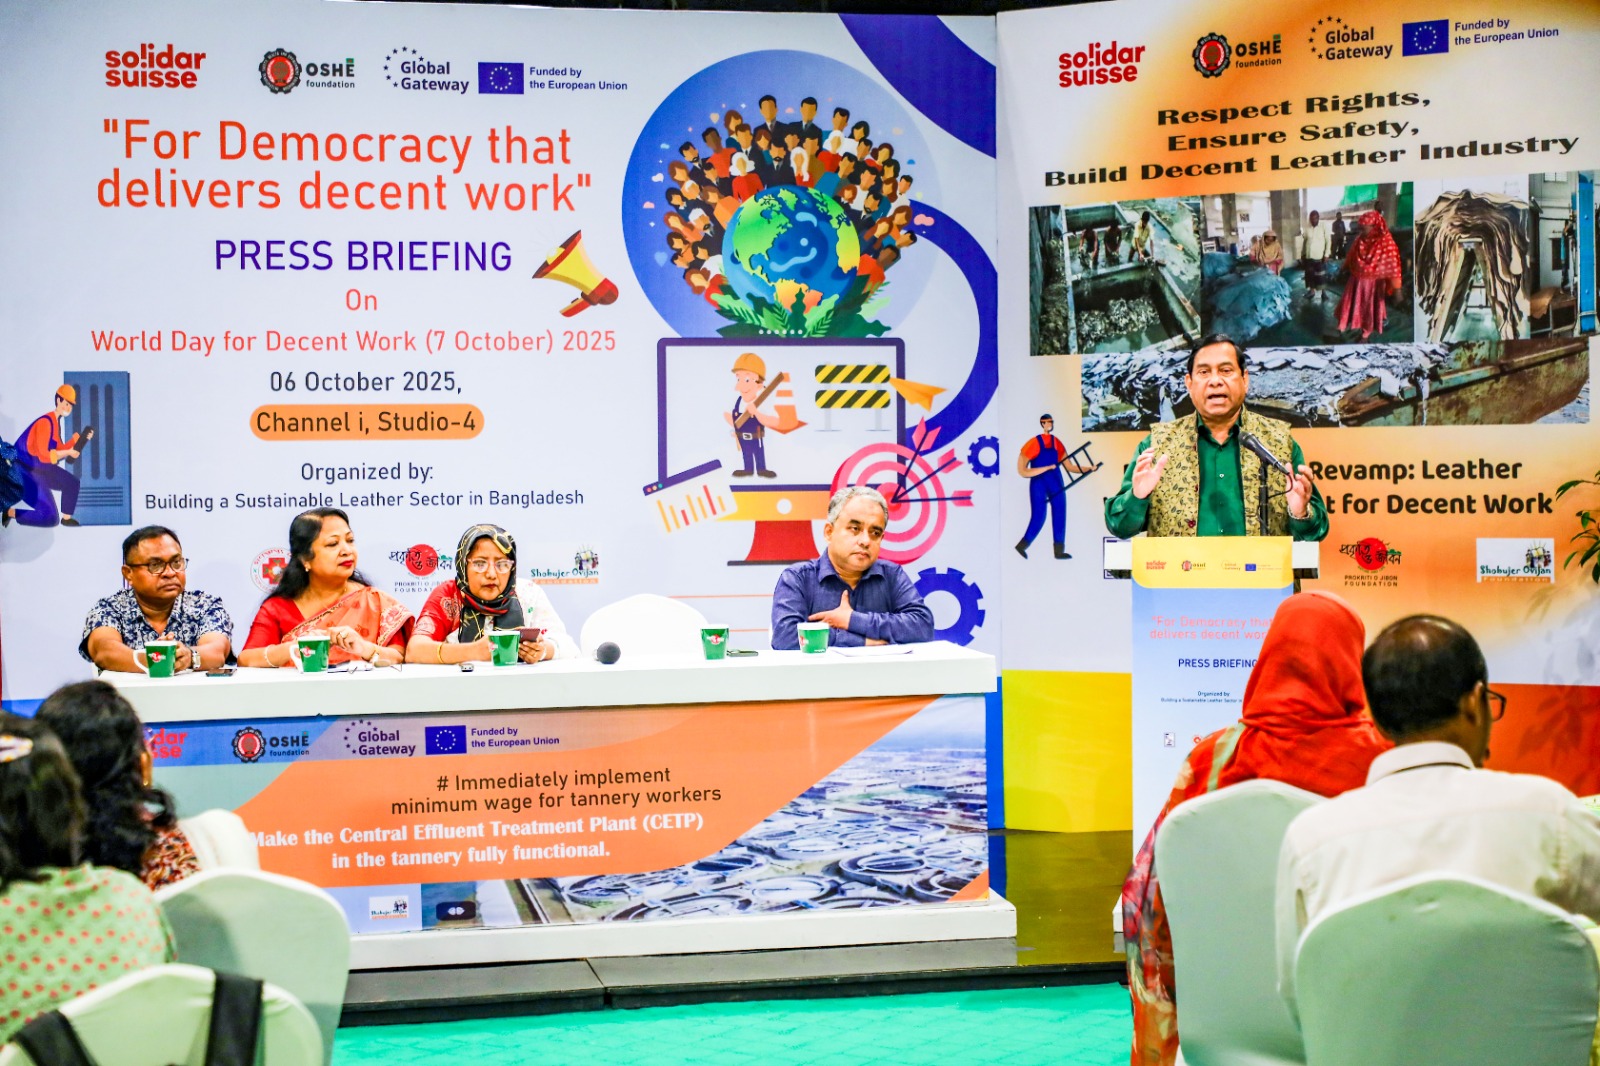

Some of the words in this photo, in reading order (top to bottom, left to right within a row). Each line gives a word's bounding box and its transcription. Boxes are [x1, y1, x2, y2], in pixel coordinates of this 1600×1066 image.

[1455, 20, 1494, 31] Funded
[1497, 19, 1509, 29] by
[1326, 27, 1374, 44] Global
[1455, 36, 1471, 45] the
[1474, 32, 1524, 43] European
[1528, 28, 1558, 38] Union
[1326, 44, 1393, 60] Gateway
[401, 61, 449, 75] Global
[530, 67, 566, 75] Funded
[570, 68, 581, 78] by
[1236, 58, 1281, 68] foundation
[106, 70, 197, 88] suisse
[306, 80, 354, 88] foundation
[530, 80, 545, 88] the
[548, 80, 595, 90] European
[599, 81, 627, 90] Union
[1059, 65, 1137, 87] suisse
[401, 78, 469, 94] Gateway
[1158, 100, 1292, 126] Respect
[1306, 92, 1430, 114] Rights,
[1169, 131, 1286, 151] Ensure
[1300, 120, 1419, 141] Safety,
[104, 119, 201, 159] "For
[220, 121, 472, 173] Democracy
[488, 126, 570, 164] that
[1045, 166, 1127, 187] Build
[1141, 157, 1257, 180] Decent
[1271, 149, 1406, 170] Leather
[1421, 137, 1579, 160] Industry
[98, 168, 280, 208] delivers
[300, 170, 446, 210] decent
[465, 173, 590, 211] work"
[216, 240, 332, 270] PRESS
[348, 241, 511, 271] BRIEFING
[346, 289, 377, 310] On
[91, 331, 161, 351] World
[172, 331, 214, 356] Day
[224, 331, 256, 351] for
[267, 331, 347, 351] Decent
[356, 331, 416, 351] Work
[426, 329, 445, 354] (7
[455, 330, 552, 354] October)
[563, 330, 615, 350] 2025
[271, 372, 295, 391] 06
[306, 372, 394, 391] October
[404, 371, 461, 394] 2025,
[257, 411, 350, 432] Channel
[360, 412, 369, 435] i,
[378, 411, 475, 431] Studio-4
[301, 462, 400, 485] Organized
[409, 462, 433, 484] by:
[1309, 461, 1414, 484] Revamp:
[1423, 458, 1522, 479] Leather
[145, 494, 213, 512] Building
[220, 498, 228, 508] a
[235, 493, 333, 508] Sustainable
[340, 492, 403, 506] Leather
[410, 492, 463, 506] Sector
[470, 491, 482, 505] in
[490, 490, 583, 508] Bangladesh
[1343, 493, 1379, 514] for
[1387, 495, 1476, 514] Decent
[1484, 493, 1552, 513] Work
[1180, 616, 1246, 629] Democracy
[1150, 629, 1197, 639] delivers
[1201, 629, 1239, 639] decent
[1244, 631, 1267, 639] wor
[1179, 659, 1210, 667] PRESS
[358, 730, 400, 742] Global
[472, 727, 504, 736] Funded
[508, 727, 518, 736] by
[358, 744, 416, 757] Gateway
[488, 739, 530, 747] European
[534, 737, 559, 745] Union
[269, 749, 310, 757] foundation
[437, 776, 448, 791] #
[456, 771, 568, 790] Immediately
[575, 768, 670, 788] implement
[392, 799, 478, 815] minimum
[485, 797, 532, 813] wage
[539, 793, 564, 807] for
[571, 793, 640, 808] tannery
[647, 787, 721, 803] workers
[250, 831, 298, 847] Make
[304, 829, 333, 844] the
[340, 825, 407, 843] Central
[414, 823, 484, 840] Effluent
[490, 819, 584, 836] Treatment
[590, 816, 636, 832] Plant
[643, 813, 703, 832] (CETP)
[332, 854, 349, 868] in
[356, 852, 385, 867] the
[392, 852, 462, 866] tannery
[468, 846, 507, 864] fully
[513, 841, 610, 860] functional.
